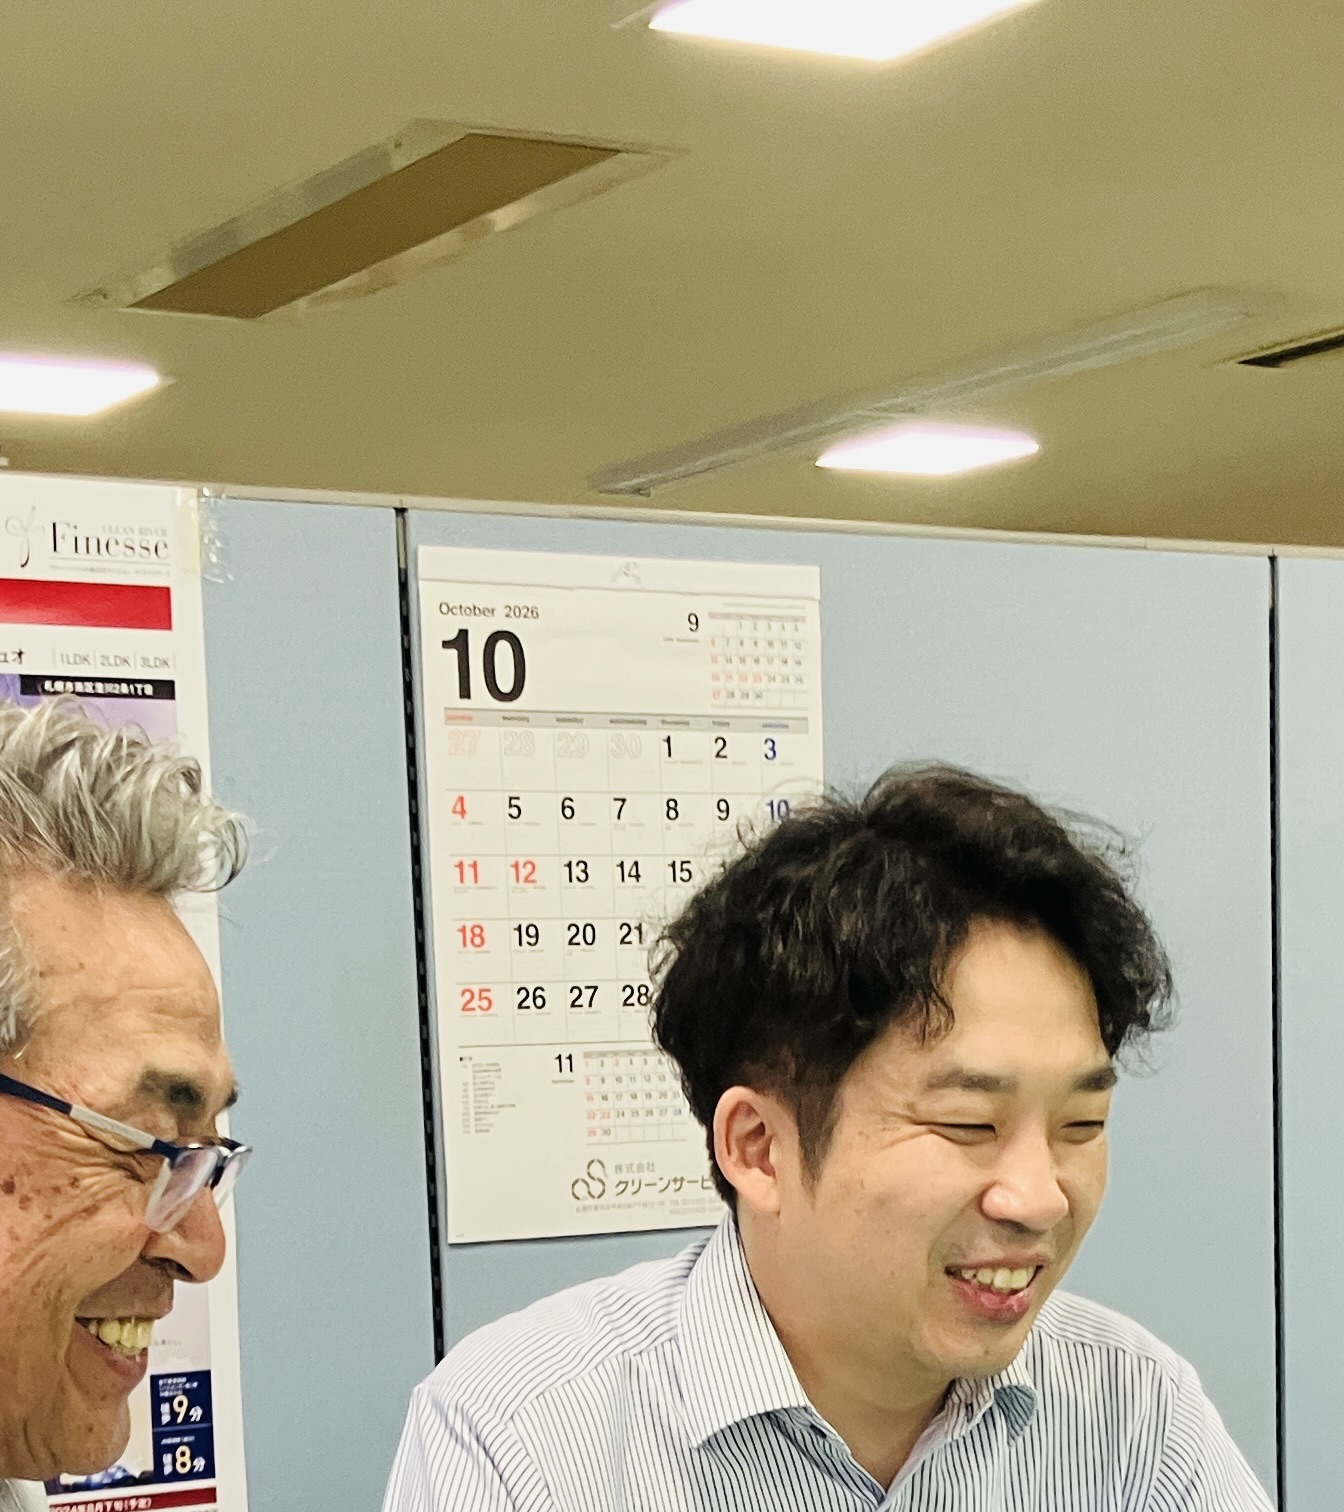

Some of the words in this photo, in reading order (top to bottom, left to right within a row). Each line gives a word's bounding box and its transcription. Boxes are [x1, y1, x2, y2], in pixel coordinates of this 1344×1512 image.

[52, 521, 169, 560] Finesse
[439, 602, 496, 617] October
[504, 604, 540, 620] 2026
[688, 613, 698, 632] 9
[442, 629, 525, 702] 10
[662, 736, 671, 757] 1
[715, 737, 727, 758] 2
[765, 738, 776, 760] 3
[452, 796, 466, 819] 4
[508, 796, 521, 819] 5
[562, 797, 574, 819] 6
[613, 798, 626, 820] 7
[666, 799, 679, 820] 8
[717, 799, 729, 821] 9
[767, 799, 790, 821] 10
[454, 861, 478, 884] 11
[511, 860, 536, 883] 12
[564, 860, 589, 883] 13
[617, 861, 641, 882] 14
[668, 860, 692, 882] 15
[458, 925, 485, 948] 18
[513, 923, 539, 946] 19
[568, 923, 595, 945] 20
[620, 923, 643, 945] 21
[461, 989, 492, 1011] 25
[517, 987, 546, 1009] 26
[570, 986, 598, 1008] 27
[622, 984, 649, 1007] 28
[555, 1054, 573, 1073] 11
